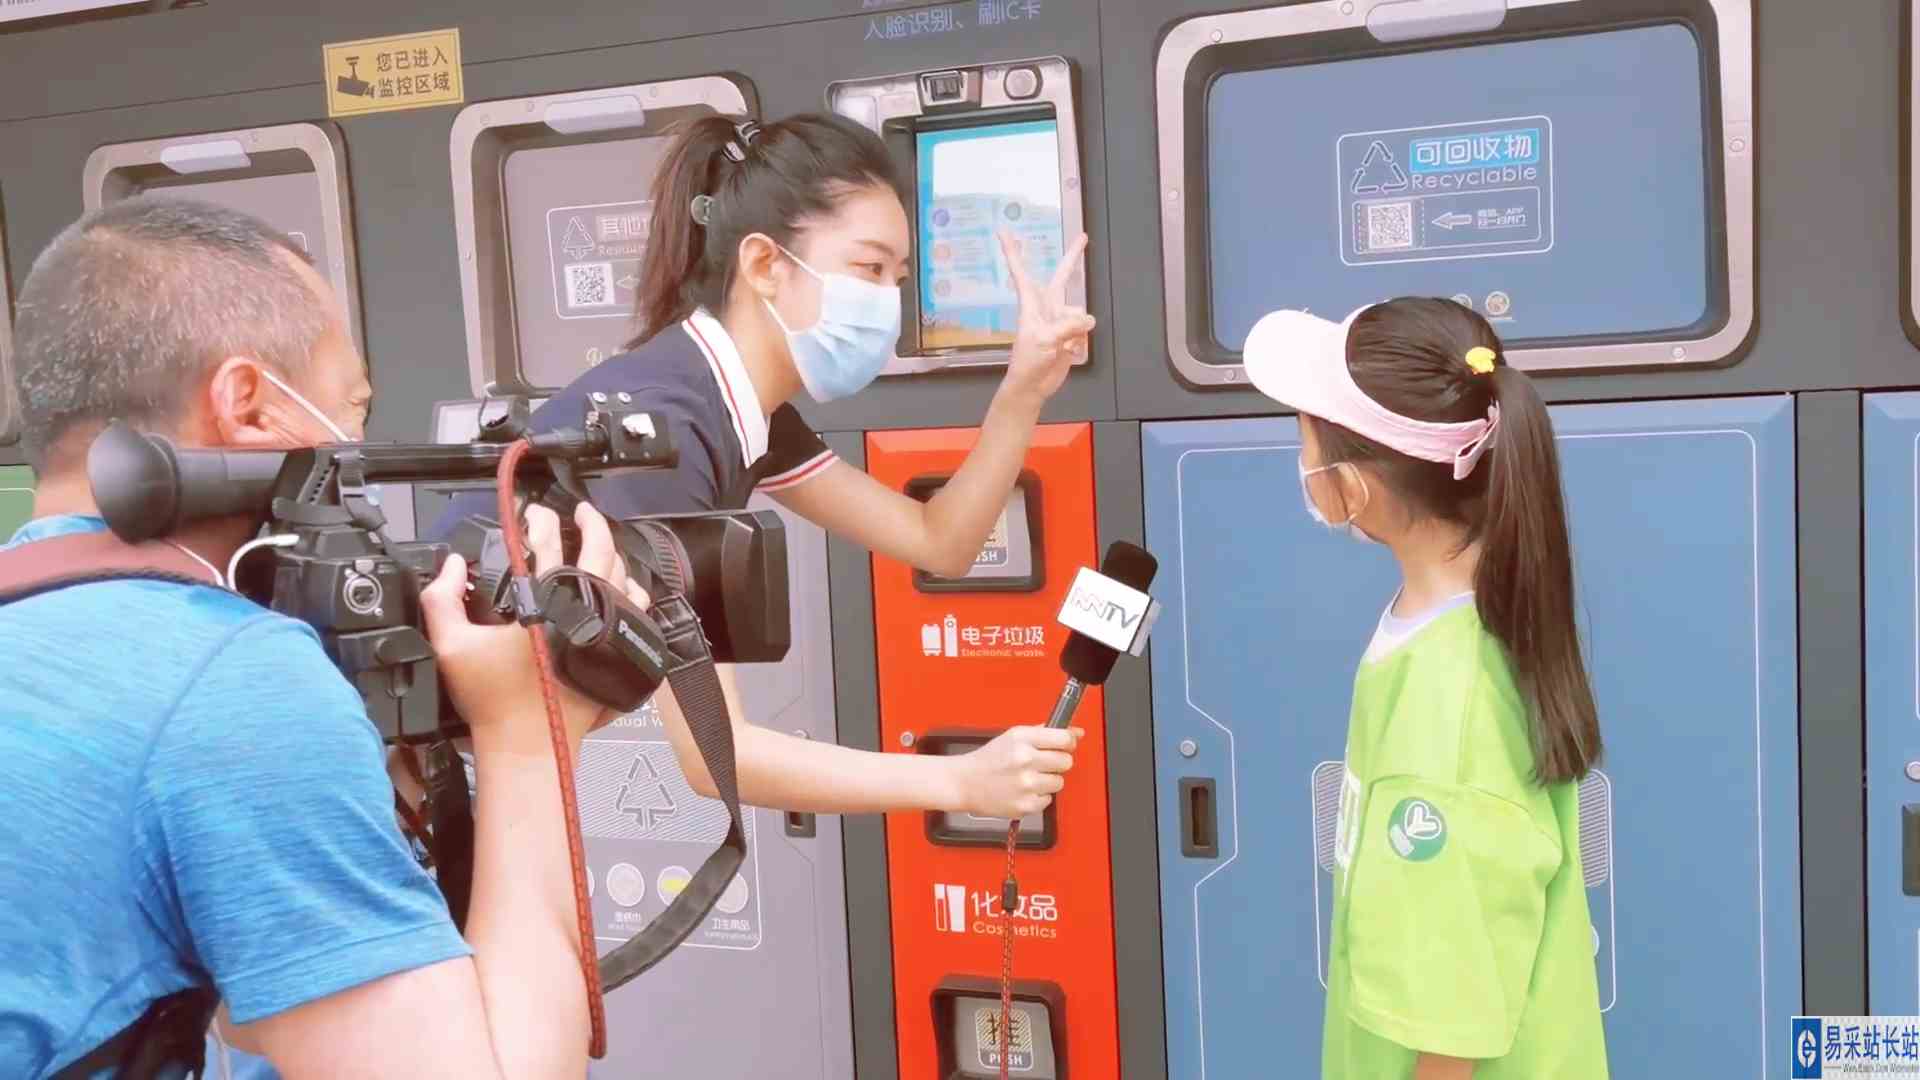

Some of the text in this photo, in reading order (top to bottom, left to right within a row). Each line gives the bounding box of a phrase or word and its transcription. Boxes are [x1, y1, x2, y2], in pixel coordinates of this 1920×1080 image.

[376, 45, 449, 73] 您已进入
[377, 71, 450, 98] 监控区域
[1415, 133, 1532, 166] 可回收物
[1411, 165, 1537, 189] Recyclable
[961, 625, 1046, 647] 电子垃圾
[972, 921, 1057, 939] Cosetics
